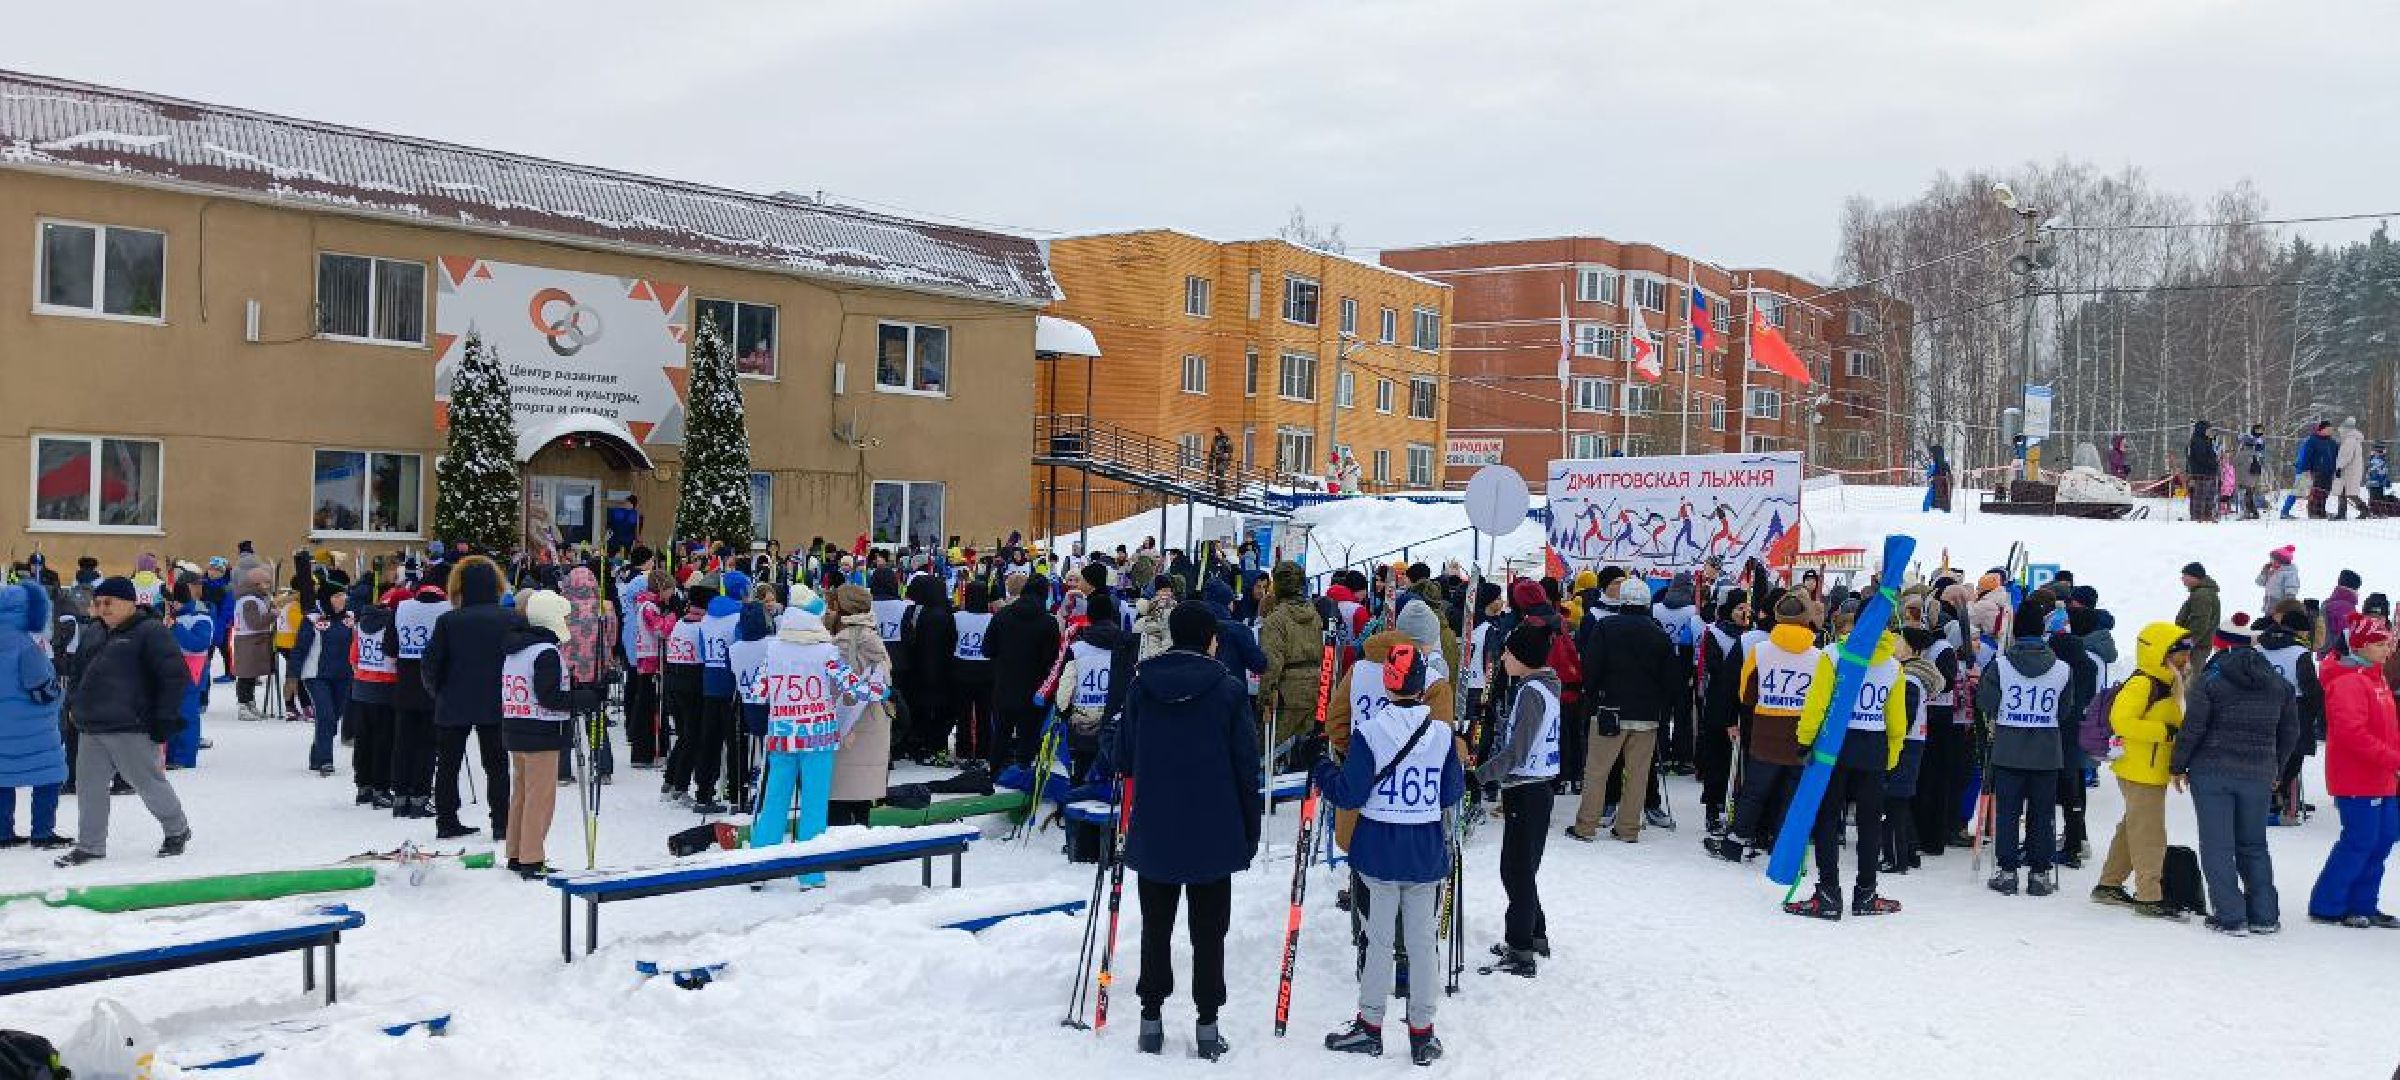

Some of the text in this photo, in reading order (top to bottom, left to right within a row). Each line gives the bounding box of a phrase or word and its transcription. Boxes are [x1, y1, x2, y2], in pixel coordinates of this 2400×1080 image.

[509, 364, 618, 384] Центр развития
[1566, 469, 1775, 492] ДМИТРОВСКАЯ ЛЫЖНЯ
[769, 674, 823, 703] 750
[1761, 668, 1812, 697] 472
[2005, 684, 2056, 713] 316
[1377, 766, 1441, 807] 465
